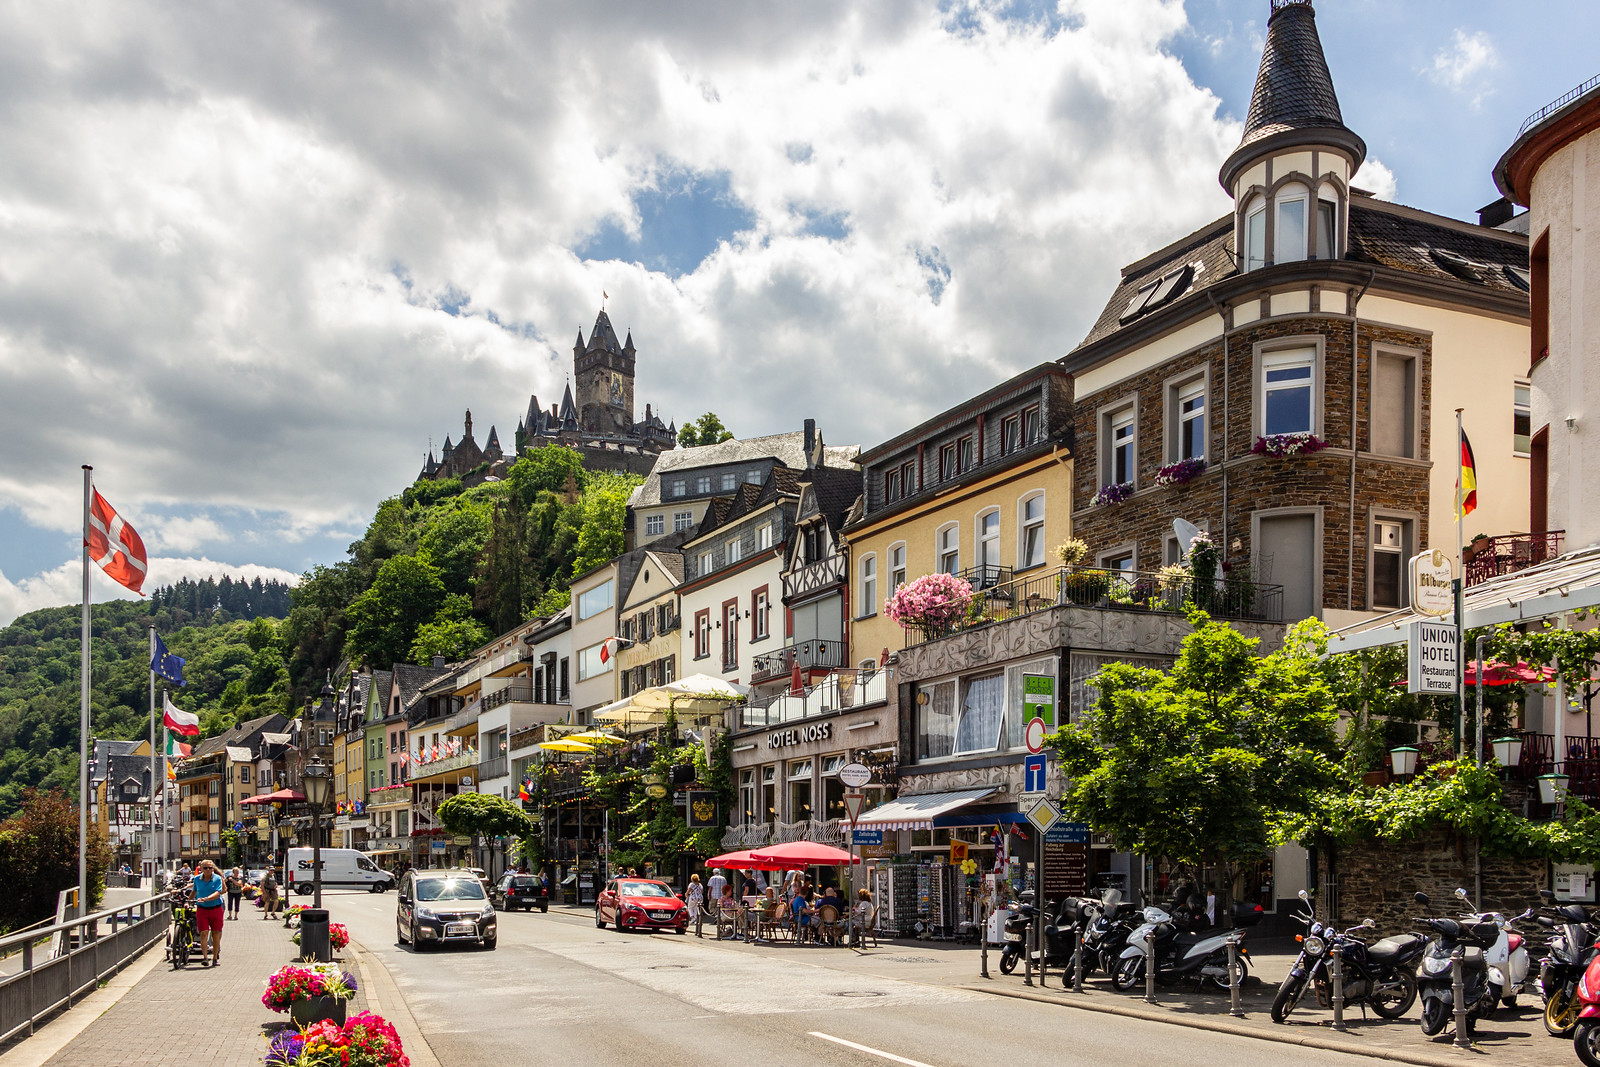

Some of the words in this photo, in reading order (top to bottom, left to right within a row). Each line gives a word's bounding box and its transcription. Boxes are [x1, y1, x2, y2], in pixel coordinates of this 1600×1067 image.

[1422, 628, 1456, 644] UNION
[1422, 647, 1456, 662] HOTEL
[1421, 665, 1456, 677] Restaurant
[1426, 678, 1452, 689] Terrasse
[767, 729, 799, 749] HOTEL
[801, 722, 831, 744] NOSS
